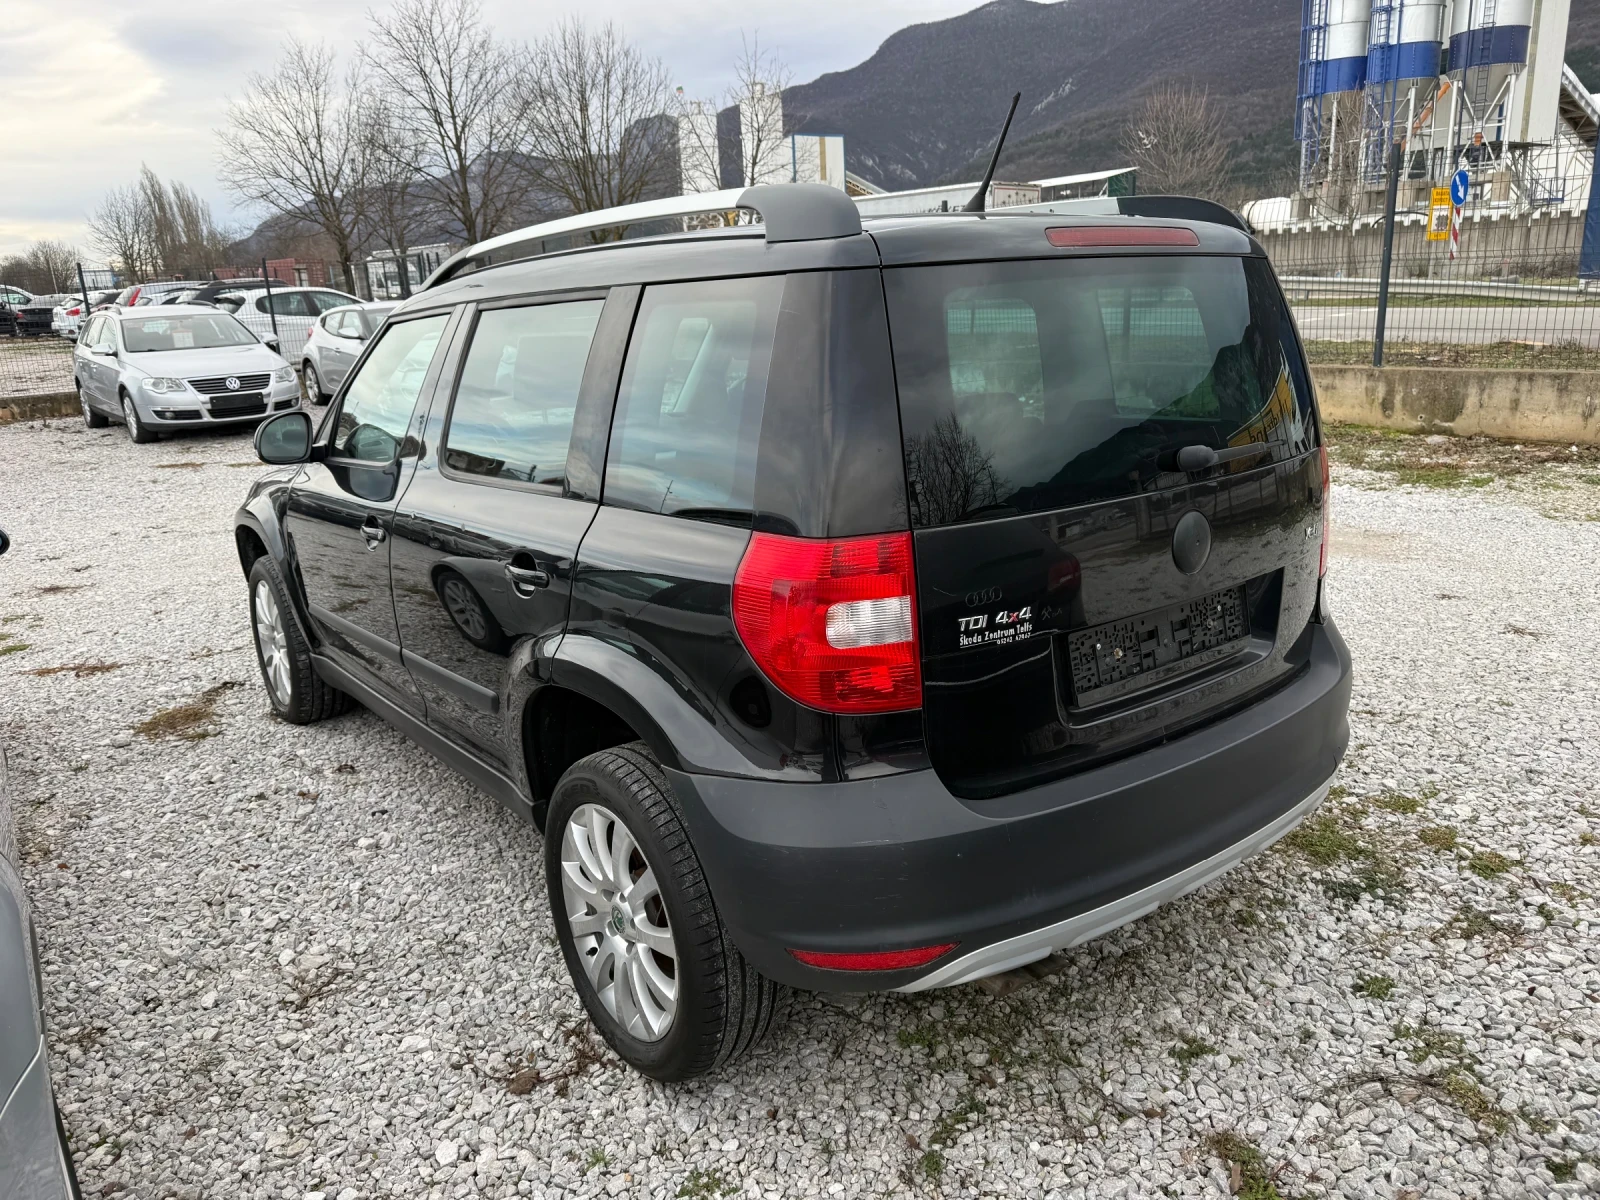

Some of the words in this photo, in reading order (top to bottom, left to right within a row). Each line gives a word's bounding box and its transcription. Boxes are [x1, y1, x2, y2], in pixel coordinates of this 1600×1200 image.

[958, 614, 988, 631] TDI
[995, 606, 1032, 624] 4x4
[959, 633, 982, 646] Škoda
[984, 628, 1015, 641] Zentrum
[1016, 622, 1033, 634] Telfs
